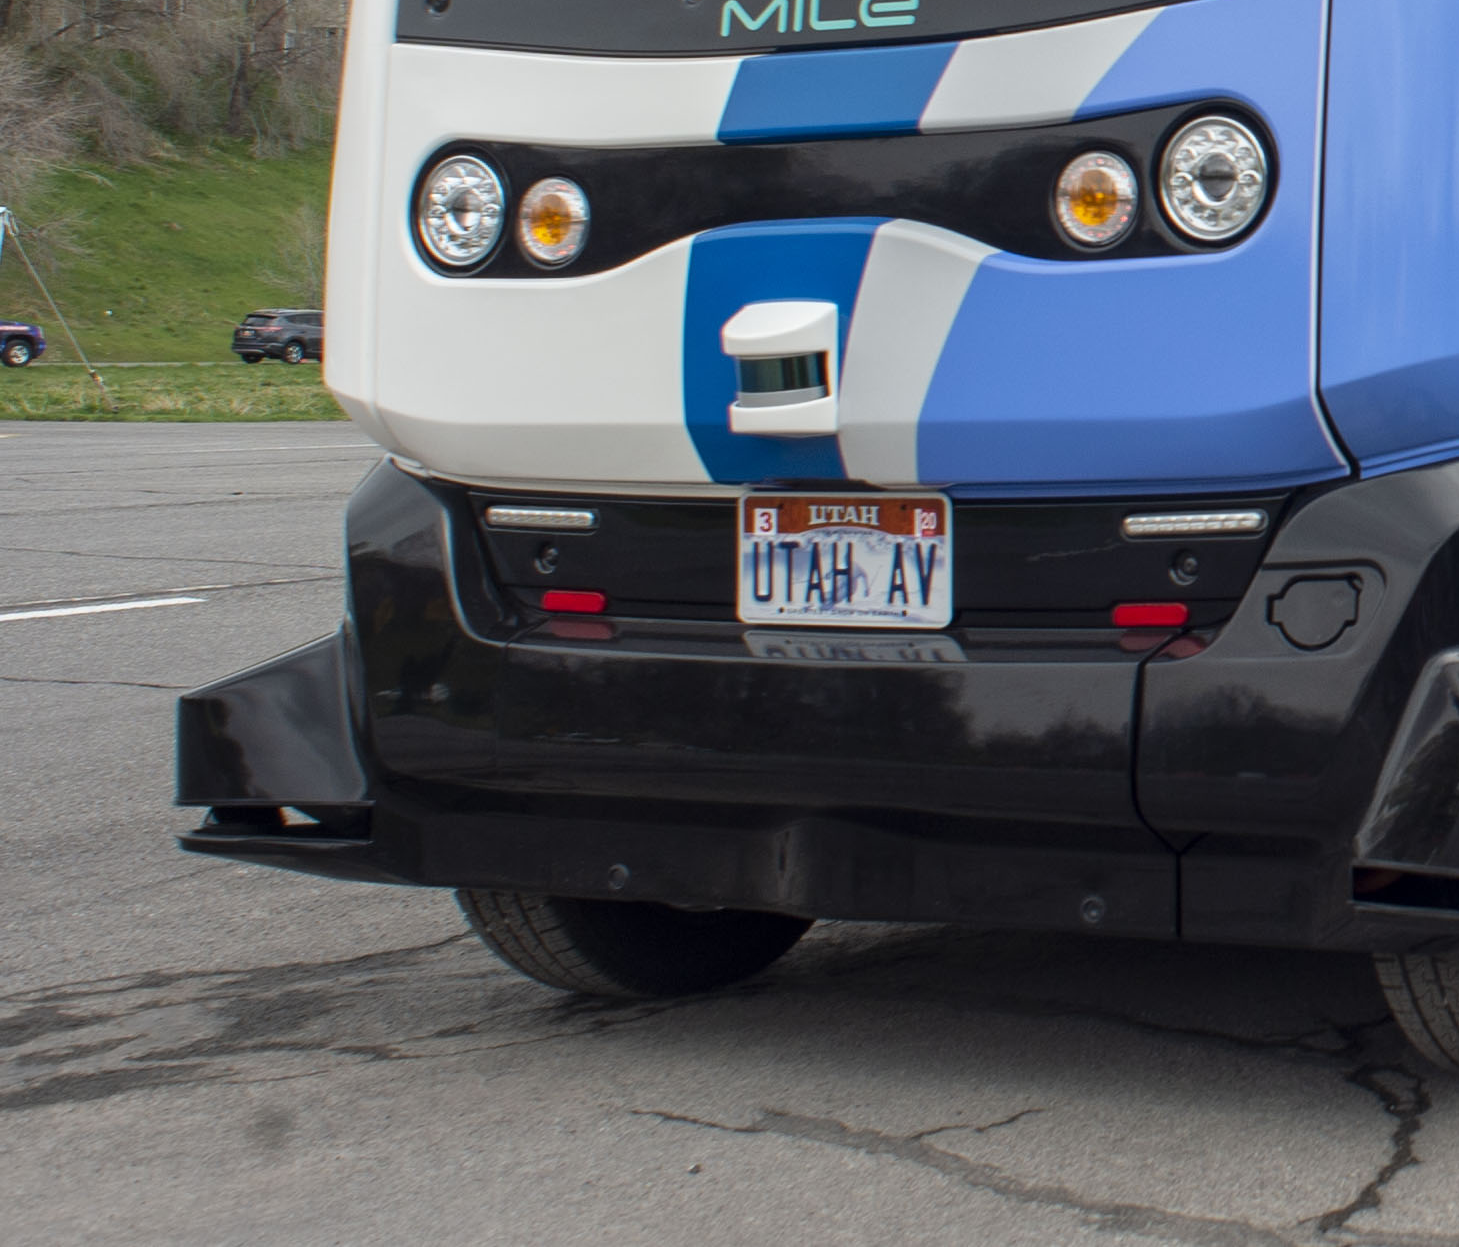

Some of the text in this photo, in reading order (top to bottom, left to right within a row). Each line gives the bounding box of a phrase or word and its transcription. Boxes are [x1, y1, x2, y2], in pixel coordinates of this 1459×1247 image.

[759, 511, 773, 532] 3
[808, 505, 880, 526] UTAH
[921, 512, 937, 530] 20
[753, 540, 938, 606] UTAH AV
